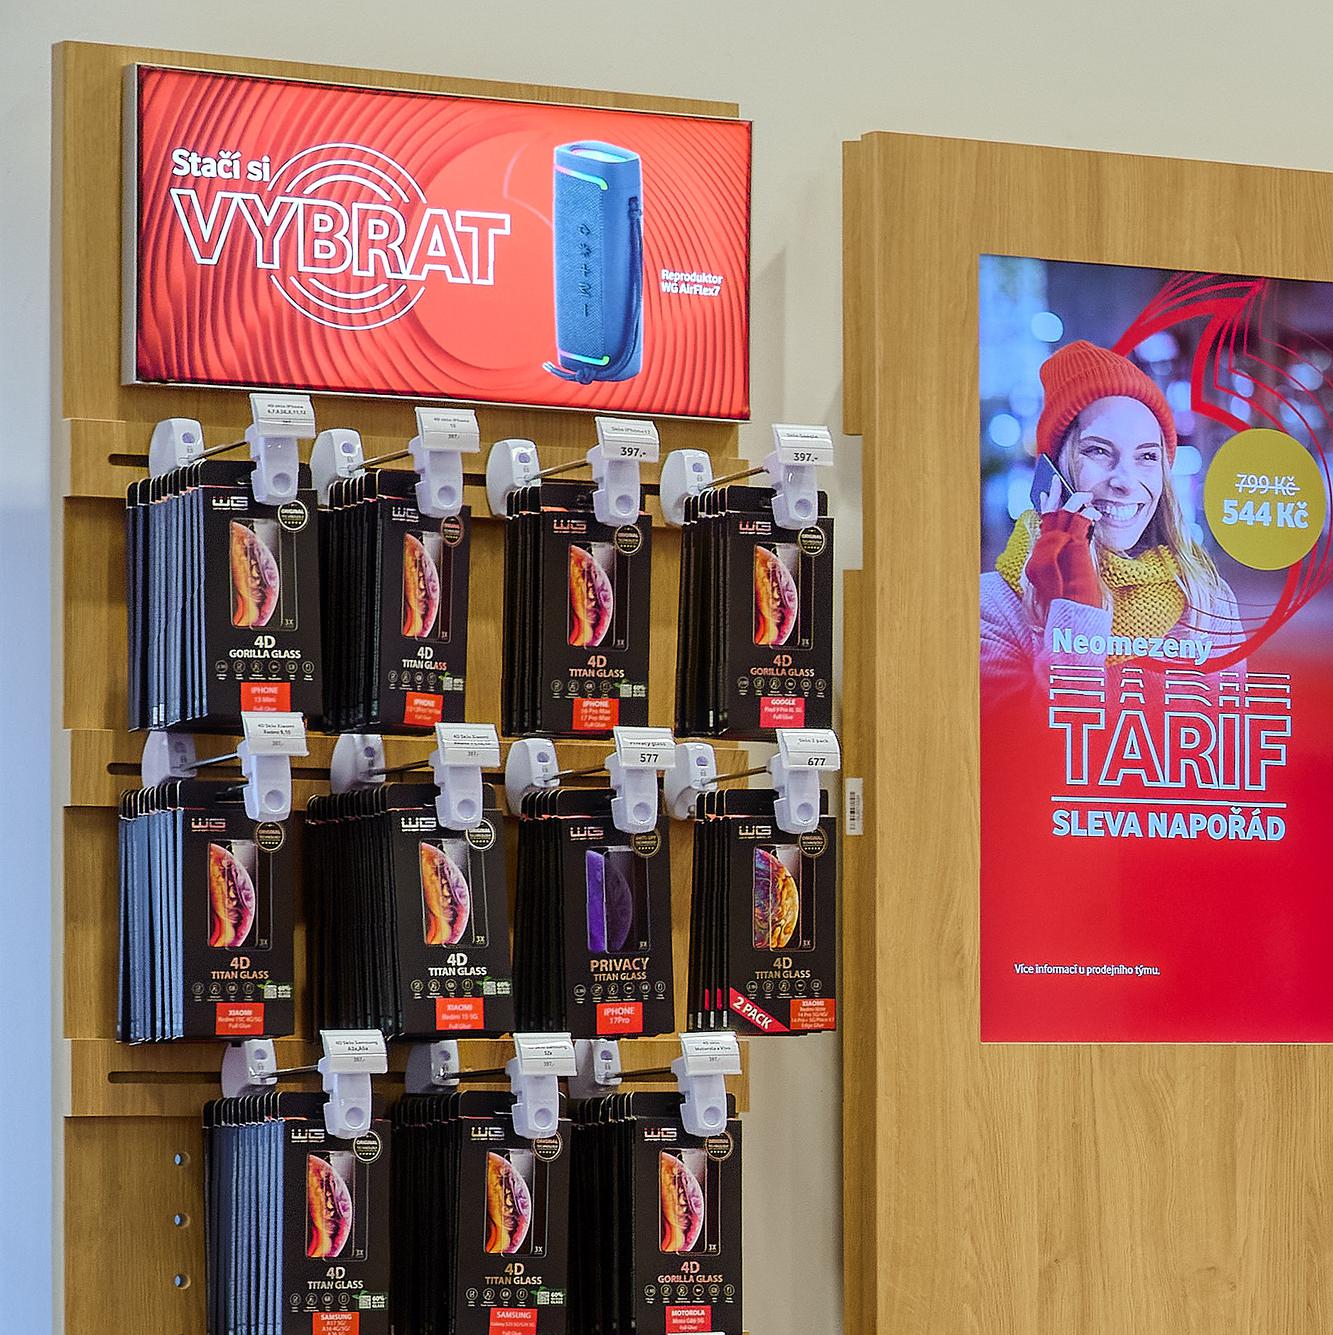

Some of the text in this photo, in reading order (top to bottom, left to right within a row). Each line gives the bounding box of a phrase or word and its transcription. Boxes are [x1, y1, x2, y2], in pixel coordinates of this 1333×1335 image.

[171, 148, 271, 182] Stačí si
[170, 187, 511, 286] VYBRAT
[661, 268, 723, 284] Reproduktor
[661, 281, 720, 297] WG AirFlex7
[1236, 473, 1296, 496] 799 Kč
[1222, 499, 1309, 529] 544 Kč
[253, 635, 276, 649] 4D
[1052, 627, 1213, 665] Neomezený
[228, 649, 301, 659] GORILLA GLASS
[417, 646, 434, 660] 4D
[402, 659, 447, 671] TITAN GLASS
[587, 655, 607, 668] 4D
[773, 654, 793, 667] 4D
[569, 668, 625, 679] TITAN GLASS
[750, 666, 815, 678] GORILLA GLASS
[1048, 706, 1292, 791] TARIF
[640, 753, 659, 763] 577
[807, 756, 826, 766] 677
[1051, 806, 1287, 841] SLEVA NAPOŘÁD
[230, 956, 250, 970] 4D
[446, 952, 468, 966] 4D
[590, 957, 650, 972] PRIVACY
[773, 957, 793, 970] 4D
[211, 970, 269, 980] TITAN GLASS
[428, 966, 487, 977] TITAN GLASS
[593, 971, 647, 982] TITAN GLASS
[755, 969, 811, 979] TITAN GLASS
[1014, 963, 1161, 977] Více informací u prodejního týmu.
[732, 996, 773, 1030] 2 PACK
[326, 1266, 346, 1279] 4D
[504, 1262, 525, 1275] 4D
[681, 1261, 700, 1274] 4D
[484, 1275, 543, 1285] TITAN GLASS
[657, 1273, 723, 1283] GORILLA GLASS
[307, 1280, 364, 1290] TITAN GLASS
[496, 1311, 532, 1319] SAMSUNG
